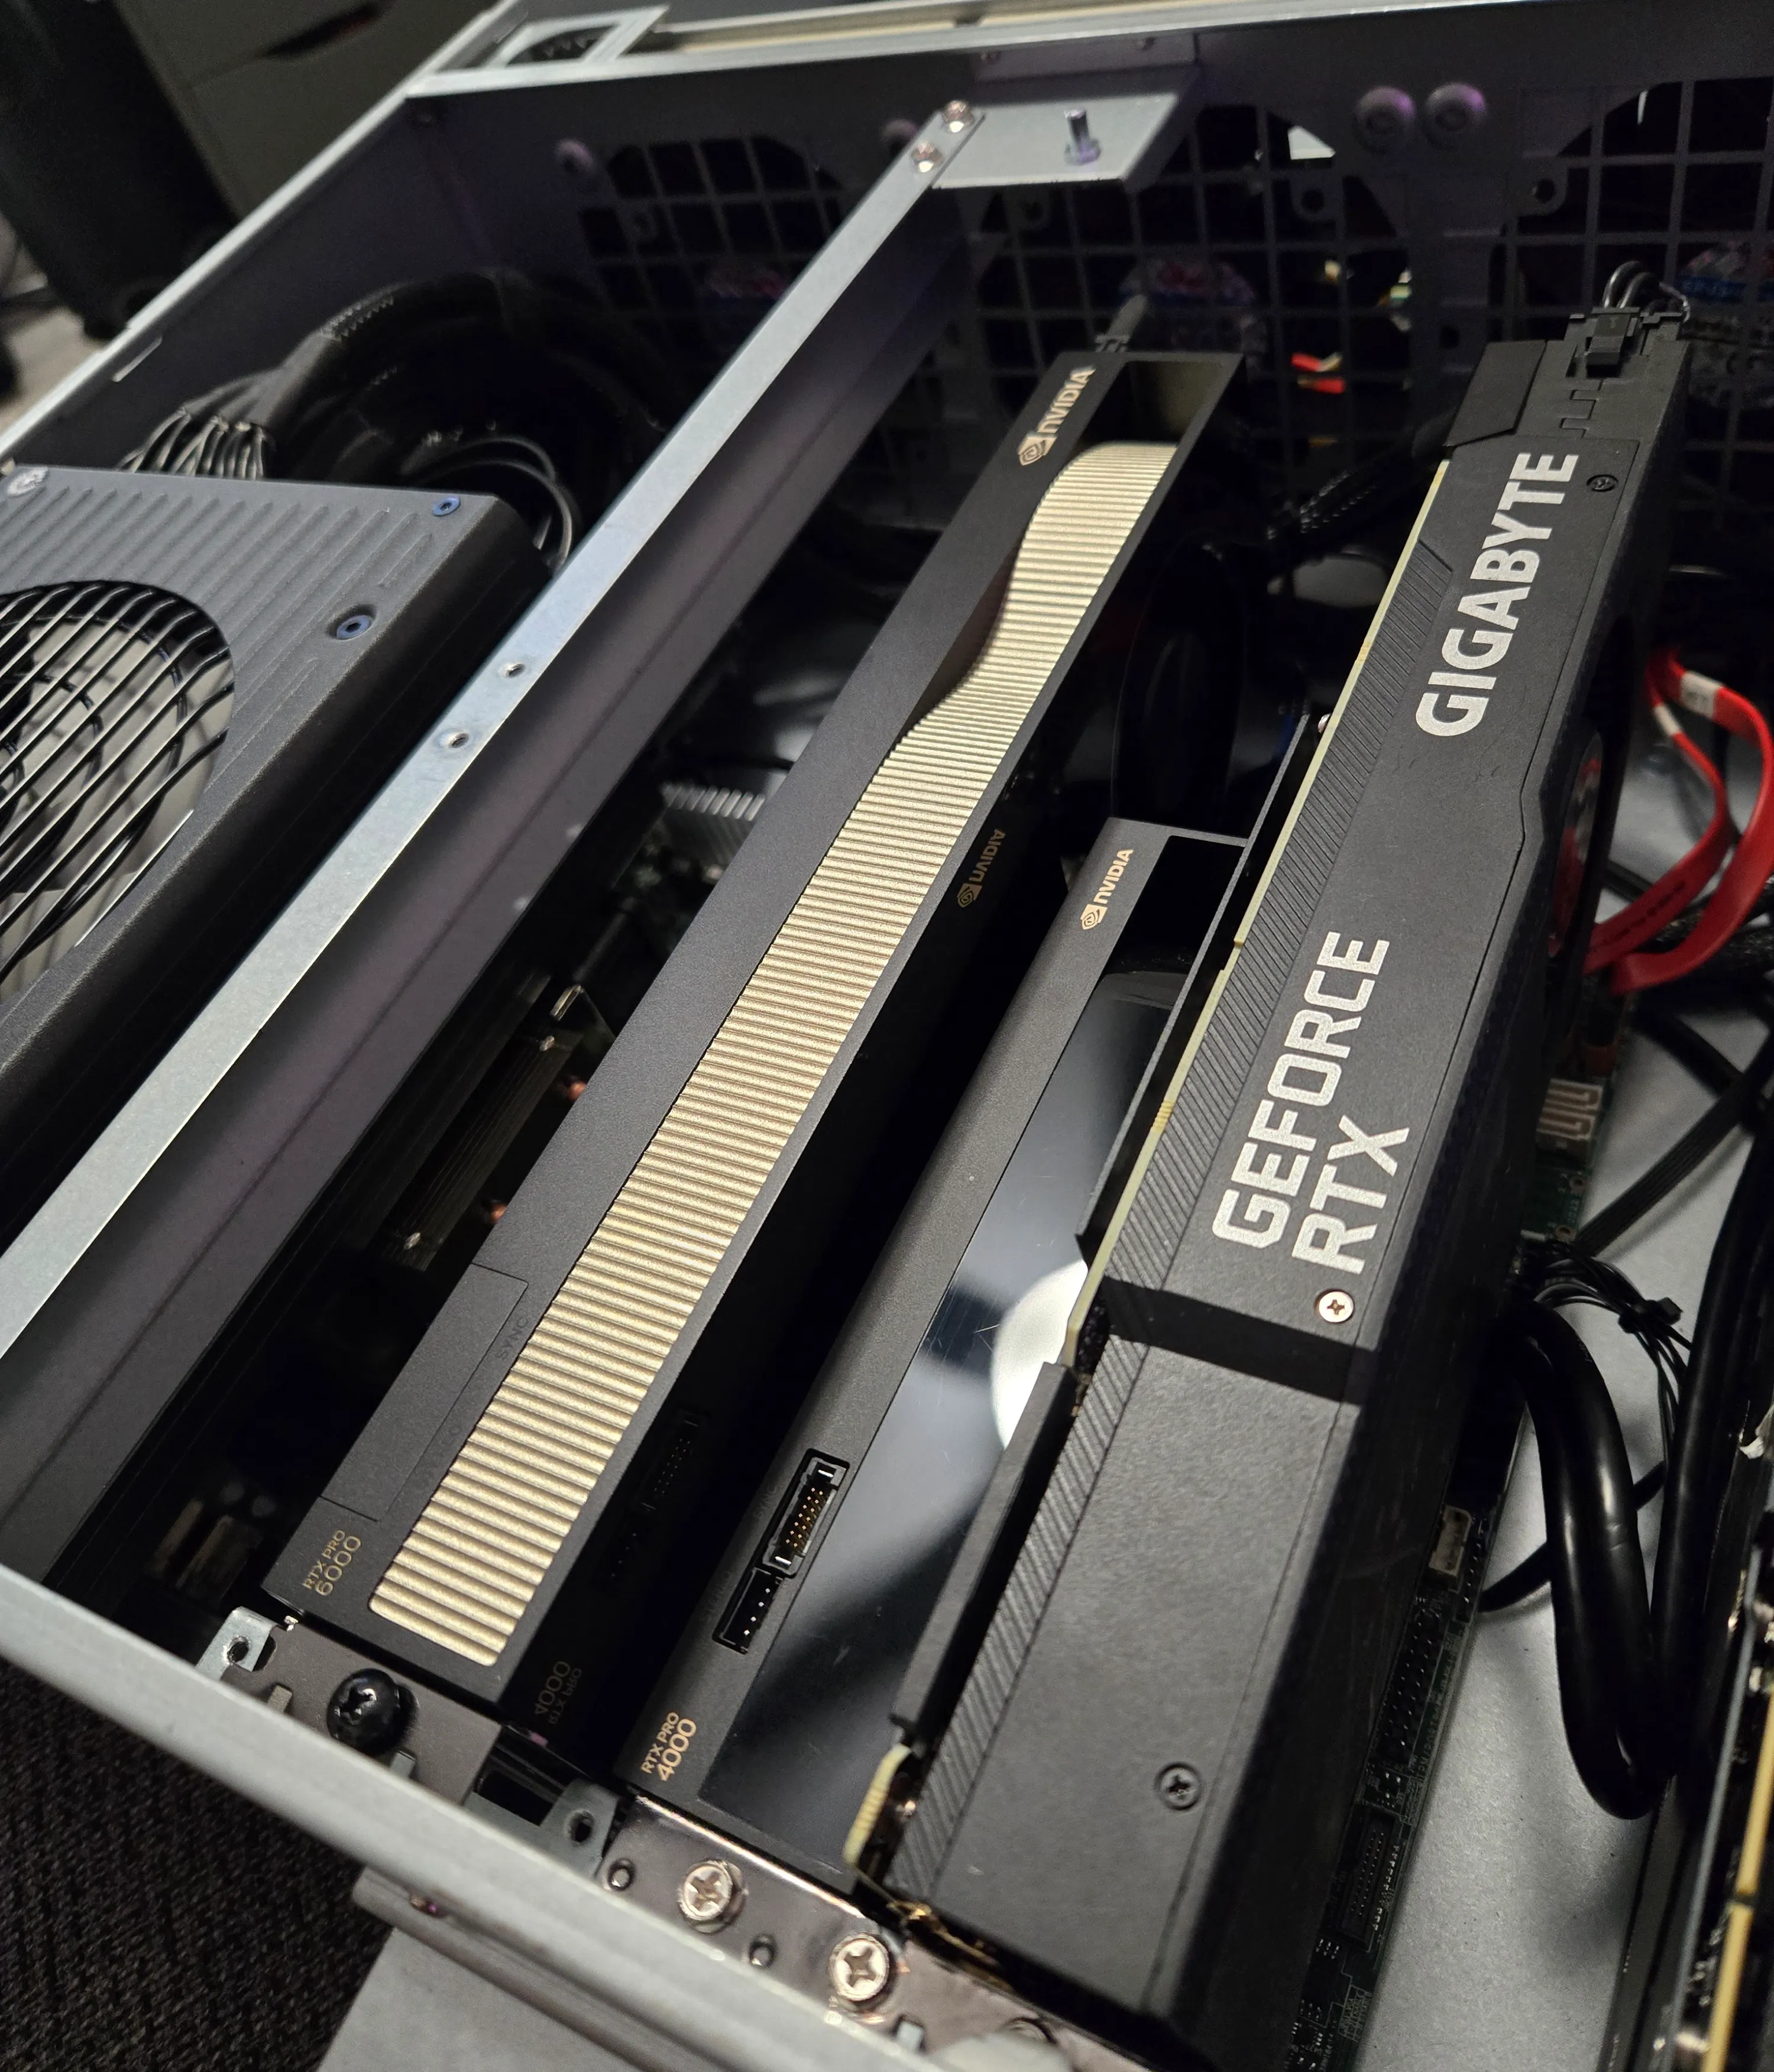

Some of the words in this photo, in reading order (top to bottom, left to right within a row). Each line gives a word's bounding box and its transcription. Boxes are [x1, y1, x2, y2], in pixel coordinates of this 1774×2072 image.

[1416, 453, 1579, 736] GIGABYTE
[1212, 932, 1390, 1248] GEFORCE
[1291, 1115, 1410, 1274] RTX
[494, 1316, 529, 1360] SYNC
[301, 1558, 326, 1589] RTX
[322, 1530, 345, 1560] PRO
[315, 1536, 361, 1596] 6000
[640, 1743, 665, 1773] RTX
[656, 1712, 679, 1743] PRO
[656, 1718, 697, 1782] 4000
